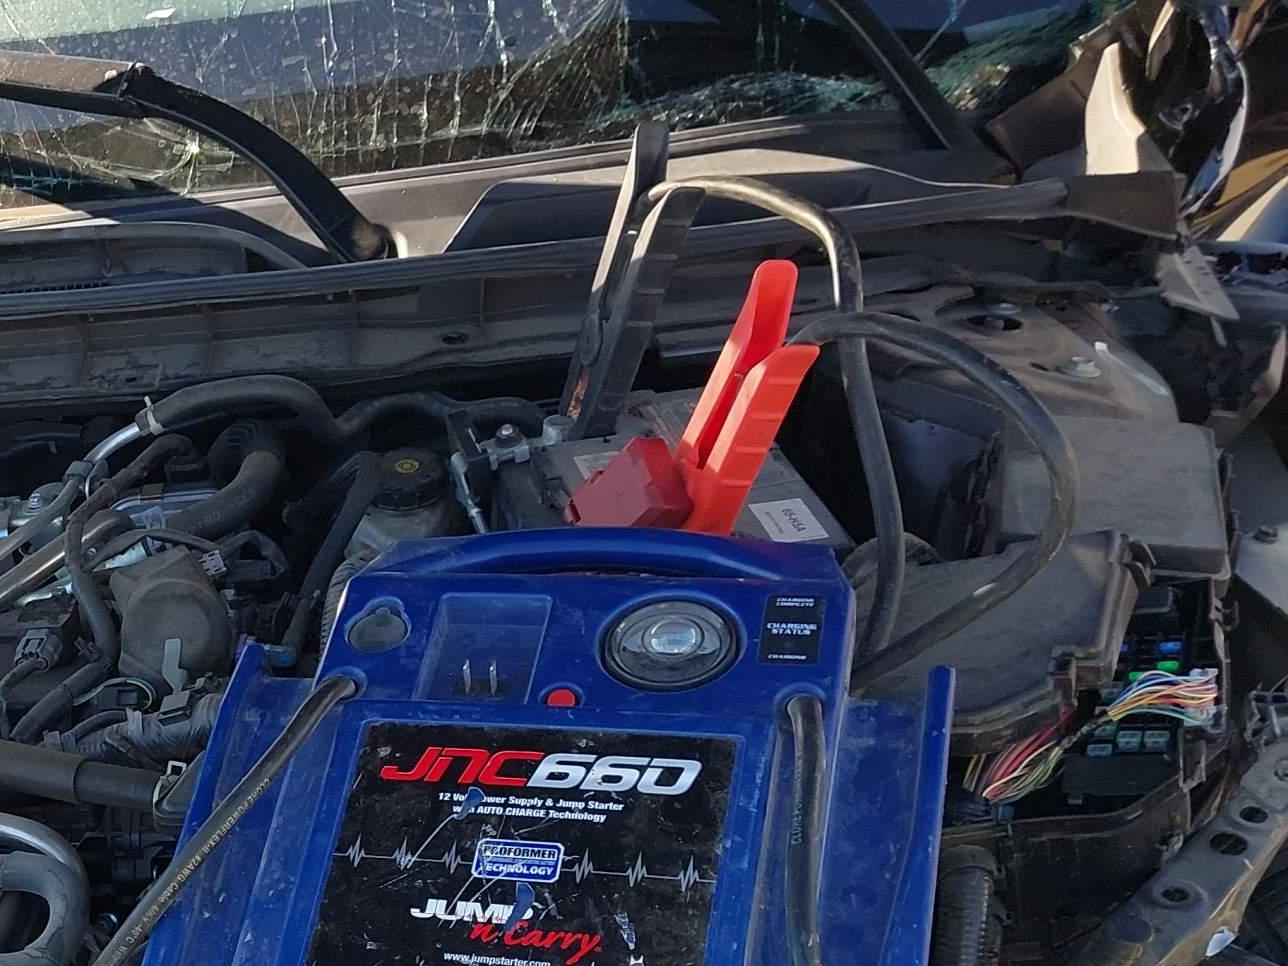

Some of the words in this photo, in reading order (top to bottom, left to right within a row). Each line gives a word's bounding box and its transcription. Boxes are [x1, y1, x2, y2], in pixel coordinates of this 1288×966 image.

[766, 622, 817, 630] CHARGING
[438, 792, 451, 801] 12
[508, 796, 544, 807] Supply
[545, 798, 554, 806] &
[556, 799, 585, 809] Jump
[586, 800, 625, 811] Starter
[476, 806, 504, 815] AUTO
[505, 808, 546, 818] CHARGE
[548, 810, 607, 823] Technology
[483, 845, 557, 859] PROFORMER
